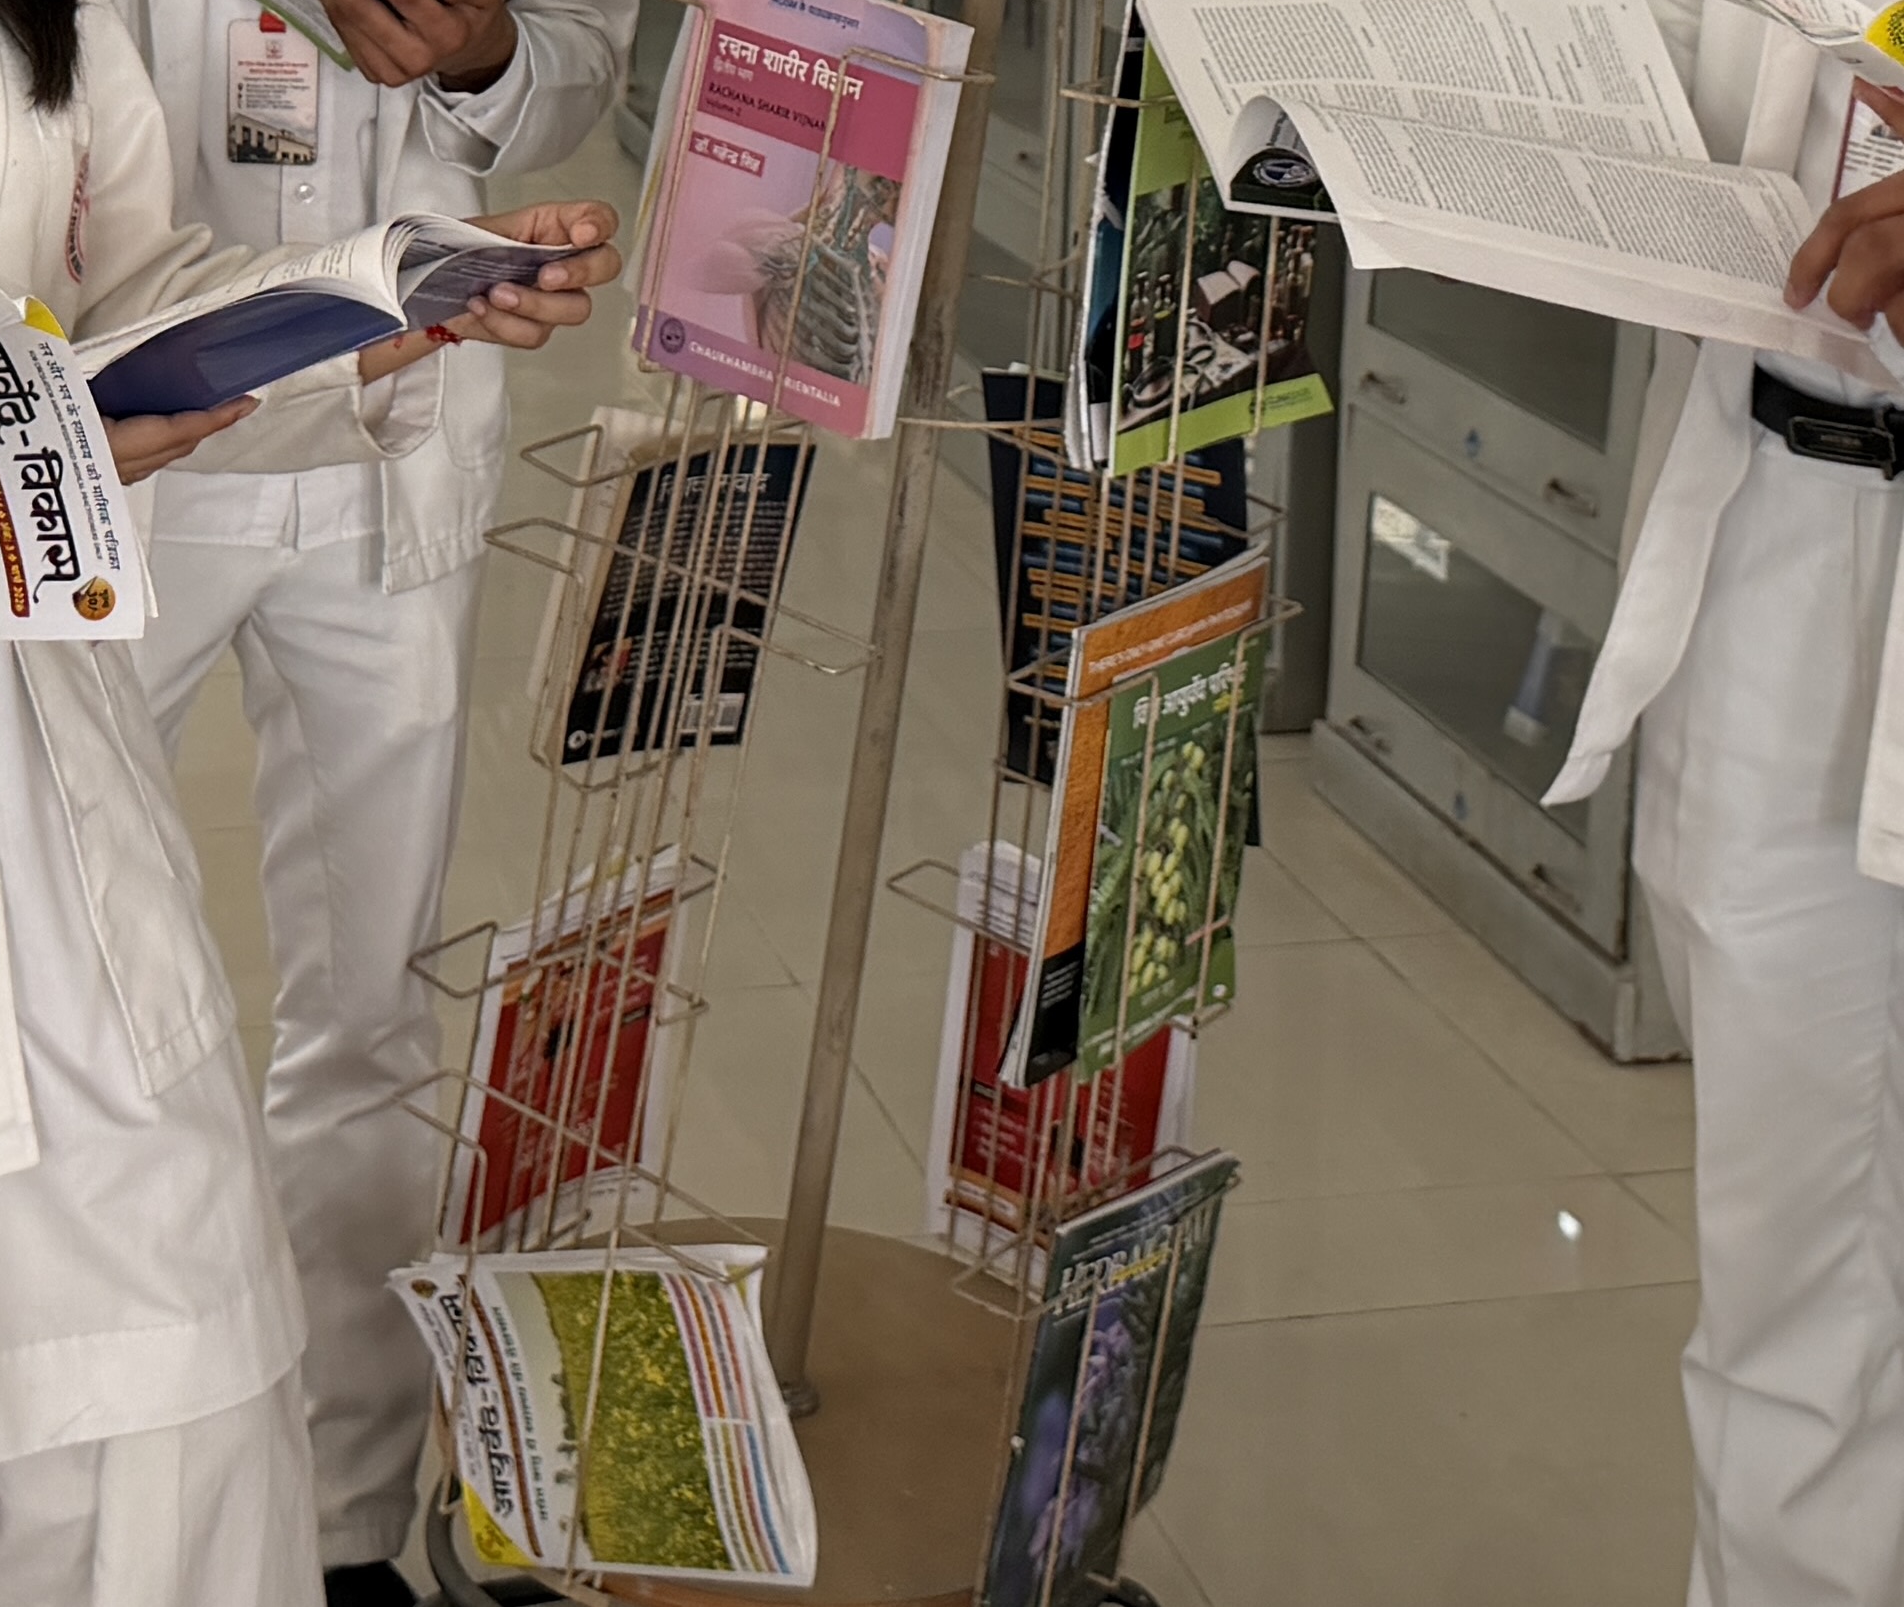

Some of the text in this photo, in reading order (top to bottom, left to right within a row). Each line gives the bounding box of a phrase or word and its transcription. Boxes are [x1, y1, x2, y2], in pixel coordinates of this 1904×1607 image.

[718, 34, 760, 65] रचना
[763, 49, 809, 84] शारीर
[709, 82, 755, 107] RACHANA
[689, 342, 842, 407] CHAUKHAMBHA RIENTALIA
[47, 358, 65, 385] और
[70, 419, 93, 459] स्वास्थ्य
[92, 485, 113, 525] मासिक
